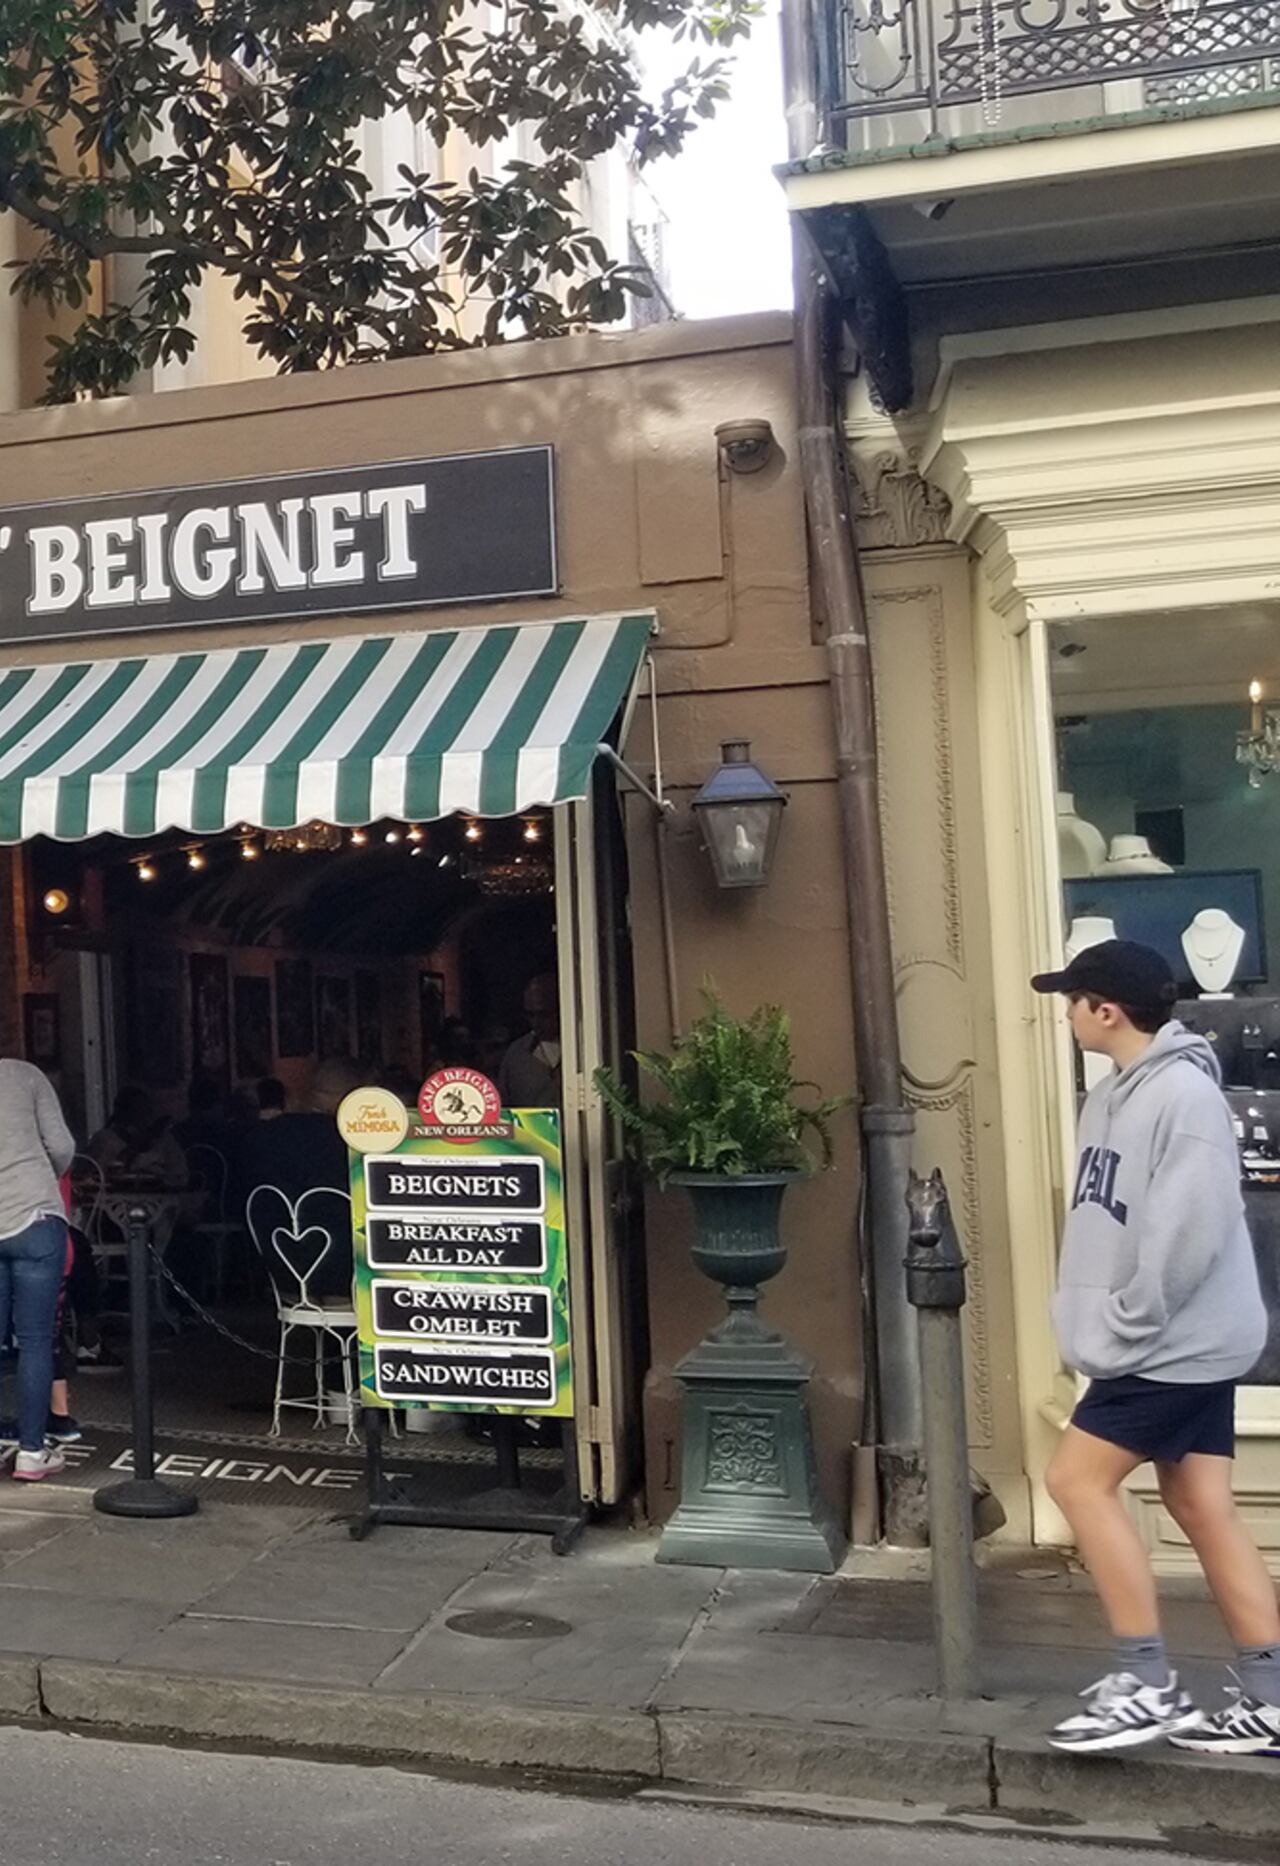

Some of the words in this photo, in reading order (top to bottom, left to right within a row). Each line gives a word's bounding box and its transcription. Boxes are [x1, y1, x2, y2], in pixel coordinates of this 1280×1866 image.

[28, 484, 426, 616] BEIGNET
[444, 1070, 497, 1112] BEIGNET
[346, 1120, 401, 1133] MIMOSA
[414, 1126, 444, 1136] NEW
[446, 1126, 509, 1136] ORLEANS
[388, 1174, 521, 1197] BEIGNETS
[387, 1224, 523, 1243] BREAKFAST
[406, 1248, 452, 1263] ALL
[456, 1249, 505, 1265] DAY
[393, 1290, 534, 1314] CRAWFISH
[409, 1315, 521, 1337] OMELET
[381, 1362, 550, 1389] SANDWICHES
